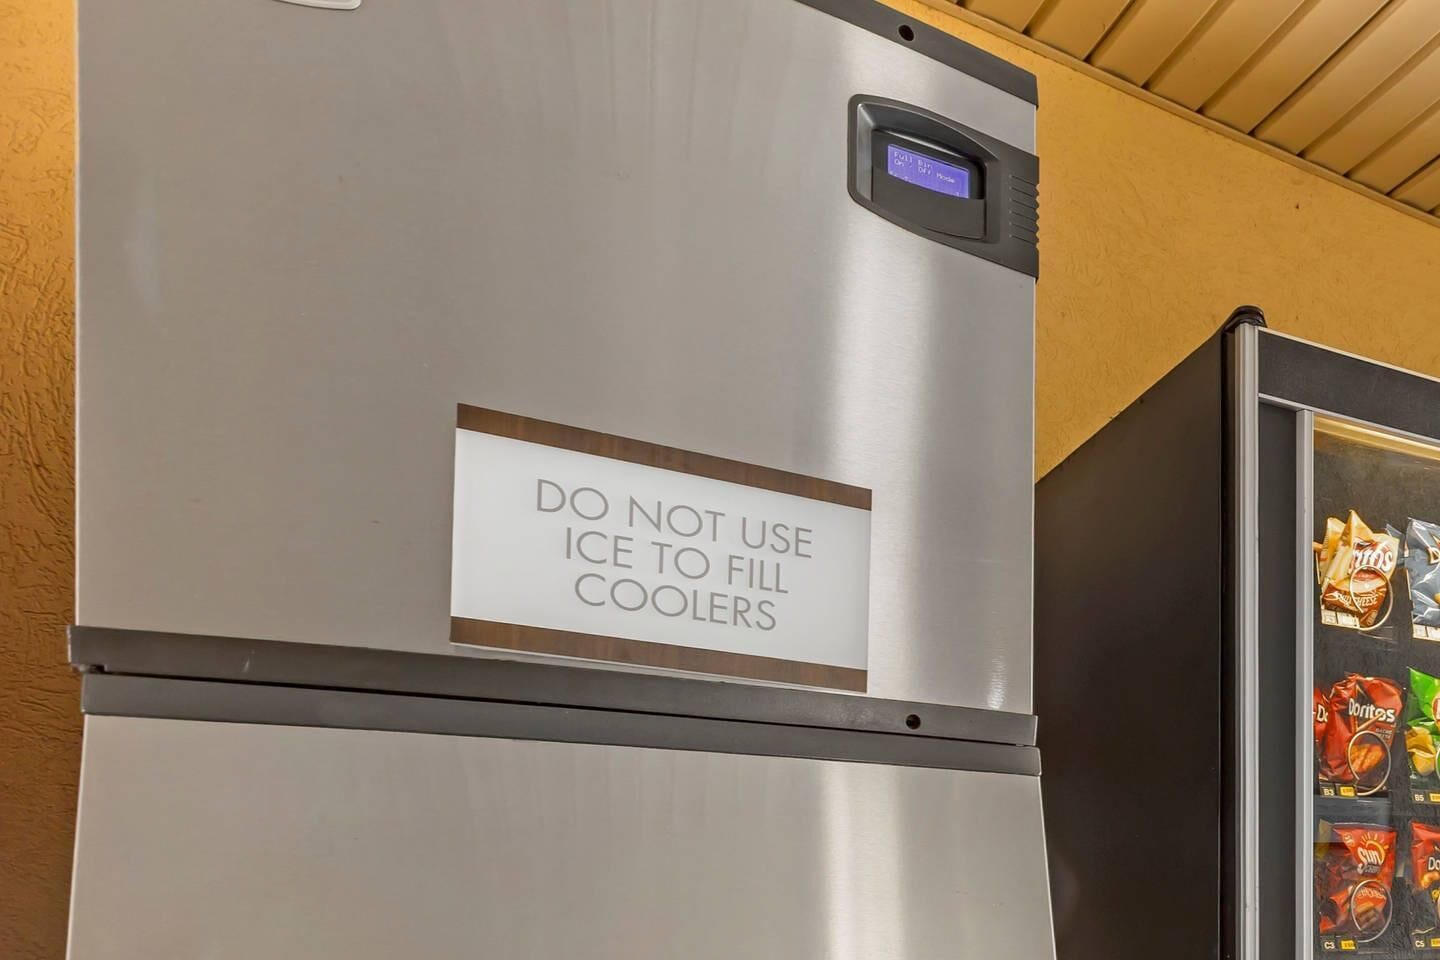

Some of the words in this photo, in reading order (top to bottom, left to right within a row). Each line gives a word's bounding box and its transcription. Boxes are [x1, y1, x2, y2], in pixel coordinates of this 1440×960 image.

[537, 478, 609, 521] DO
[628, 496, 726, 543] NOT
[741, 516, 813, 559] USE
[565, 527, 634, 569] ICE
[651, 541, 710, 580] TO
[728, 555, 789, 594] FILL
[574, 573, 777, 632] COOLERS
[1349, 697, 1396, 723] Doritos
[1324, 940, 1335, 950] C3
